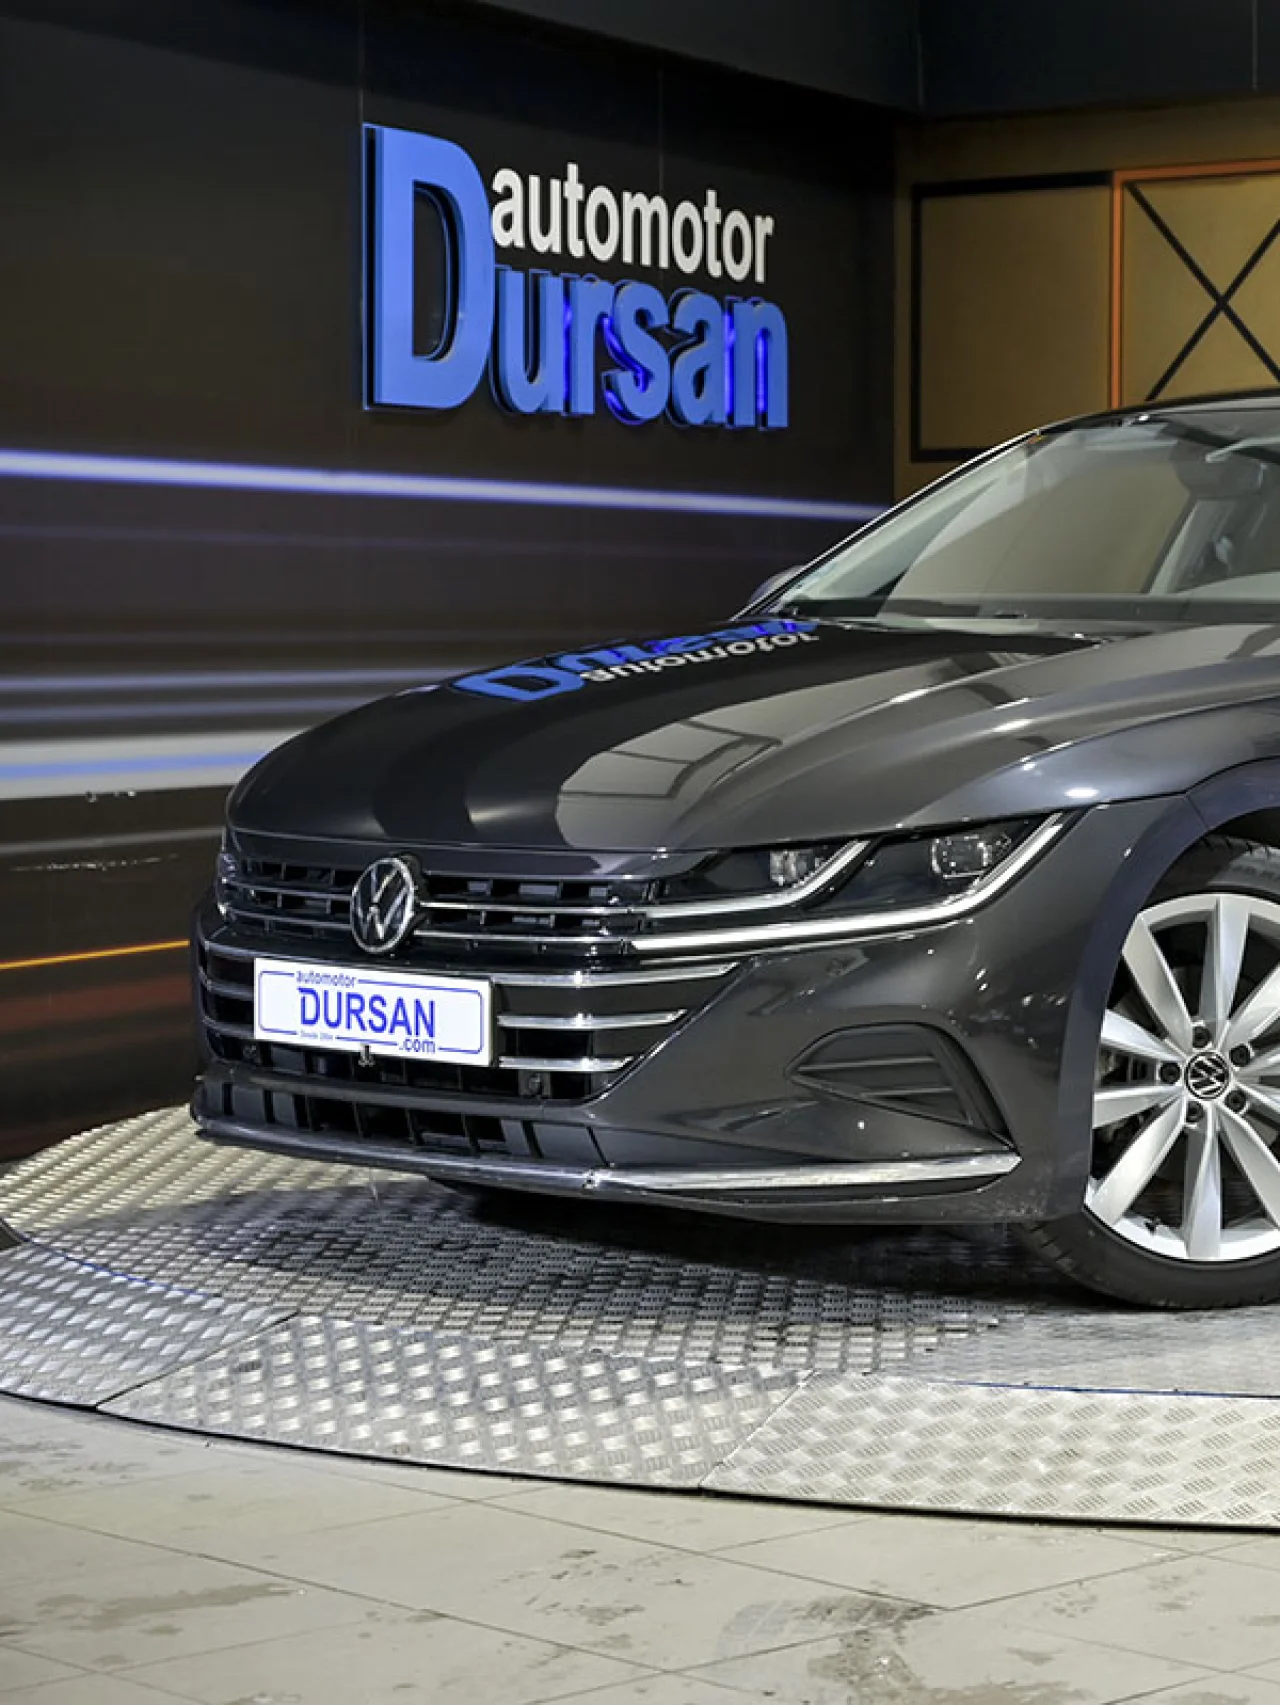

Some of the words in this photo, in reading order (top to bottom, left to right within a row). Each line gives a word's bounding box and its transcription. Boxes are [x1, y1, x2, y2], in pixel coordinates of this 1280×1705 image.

[491, 161, 775, 283] automotor
[362, 122, 789, 430] Dursan
[297, 970, 357, 988] automotor
[297, 987, 435, 1038] DURSAN
